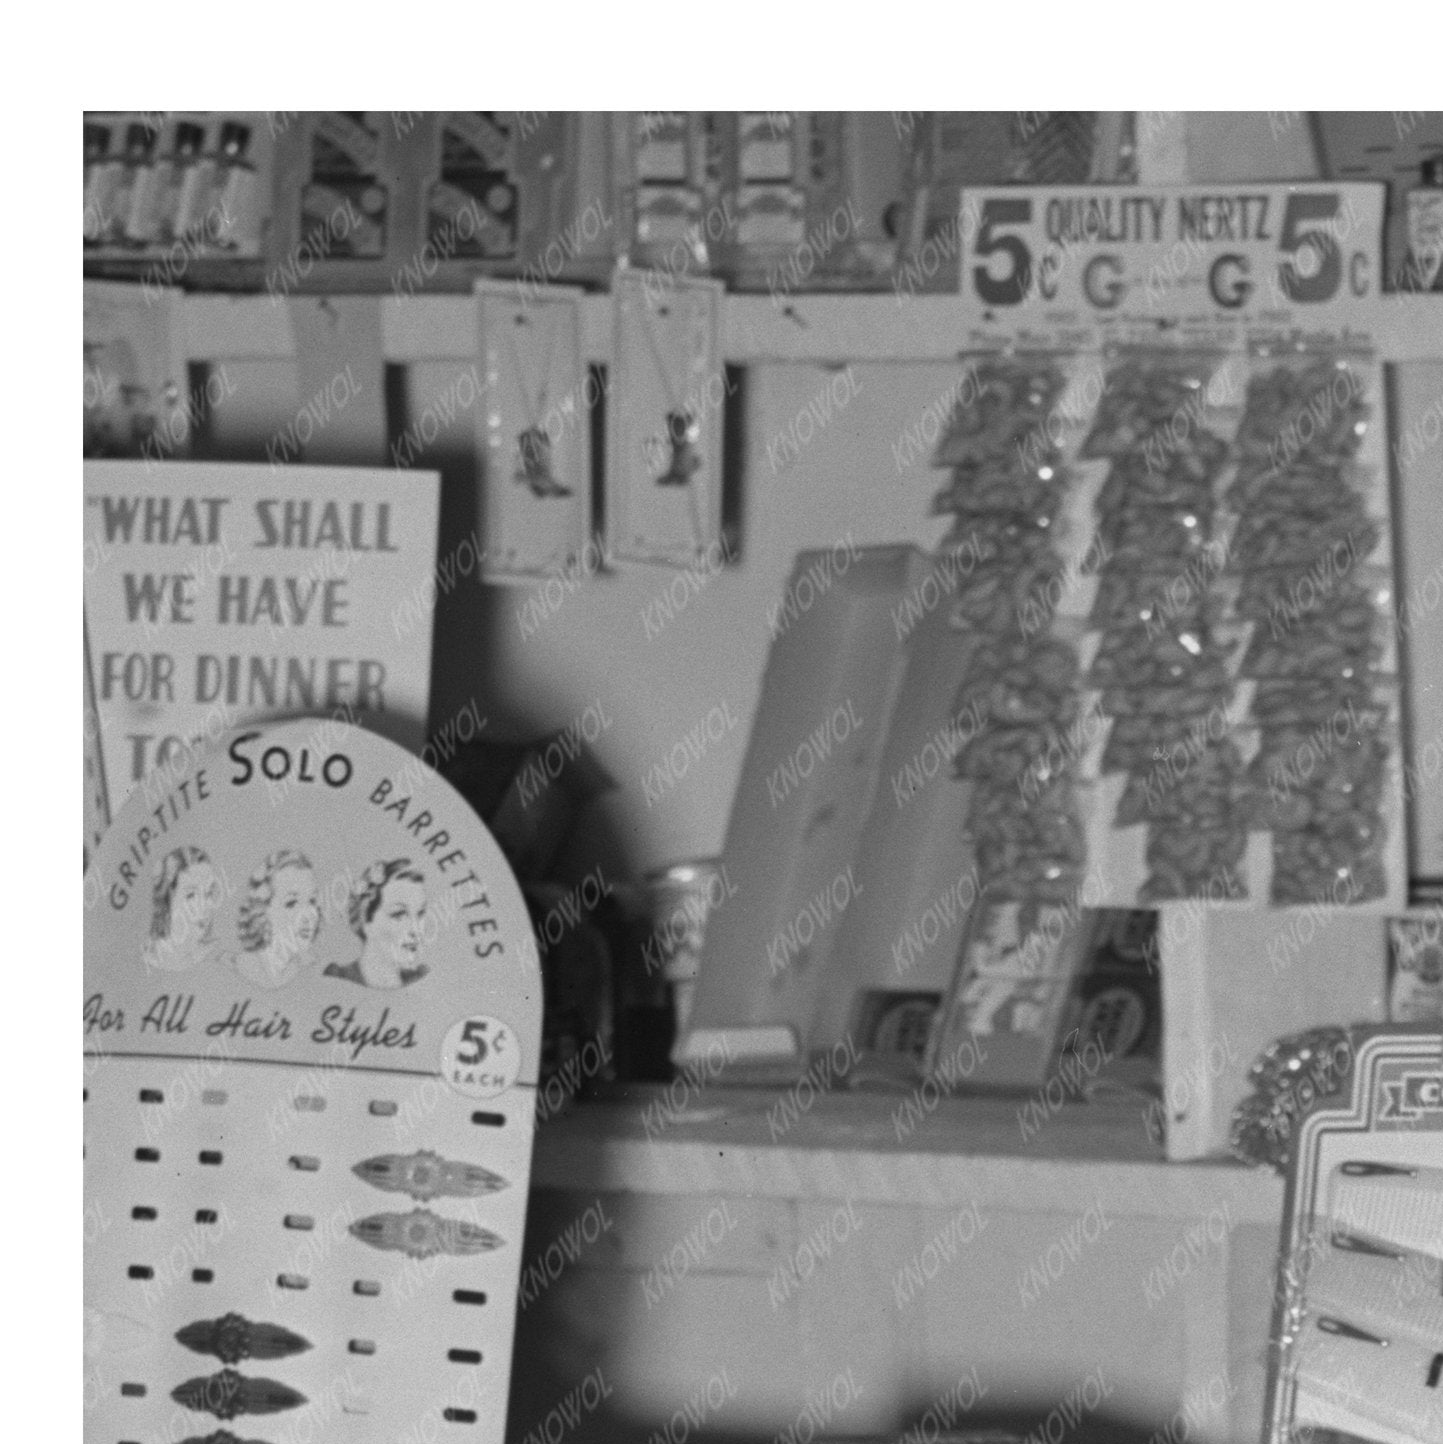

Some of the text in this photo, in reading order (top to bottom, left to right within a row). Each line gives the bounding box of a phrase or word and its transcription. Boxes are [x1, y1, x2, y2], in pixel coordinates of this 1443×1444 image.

[1046, 194, 1271, 245] QUALITY NERTZ
[253, 499, 400, 552] SHALL
[122, 572, 350, 629] WE HAVE
[101, 652, 389, 712] FOR DINNER
[108, 767, 213, 914] GRIP-TITE
[368, 776, 506, 962] BARRETTES
[139, 993, 195, 1034] All
[205, 997, 292, 1041] Hair
[312, 1004, 419, 1055] Styles
[451, 1067, 508, 1091] EACH
